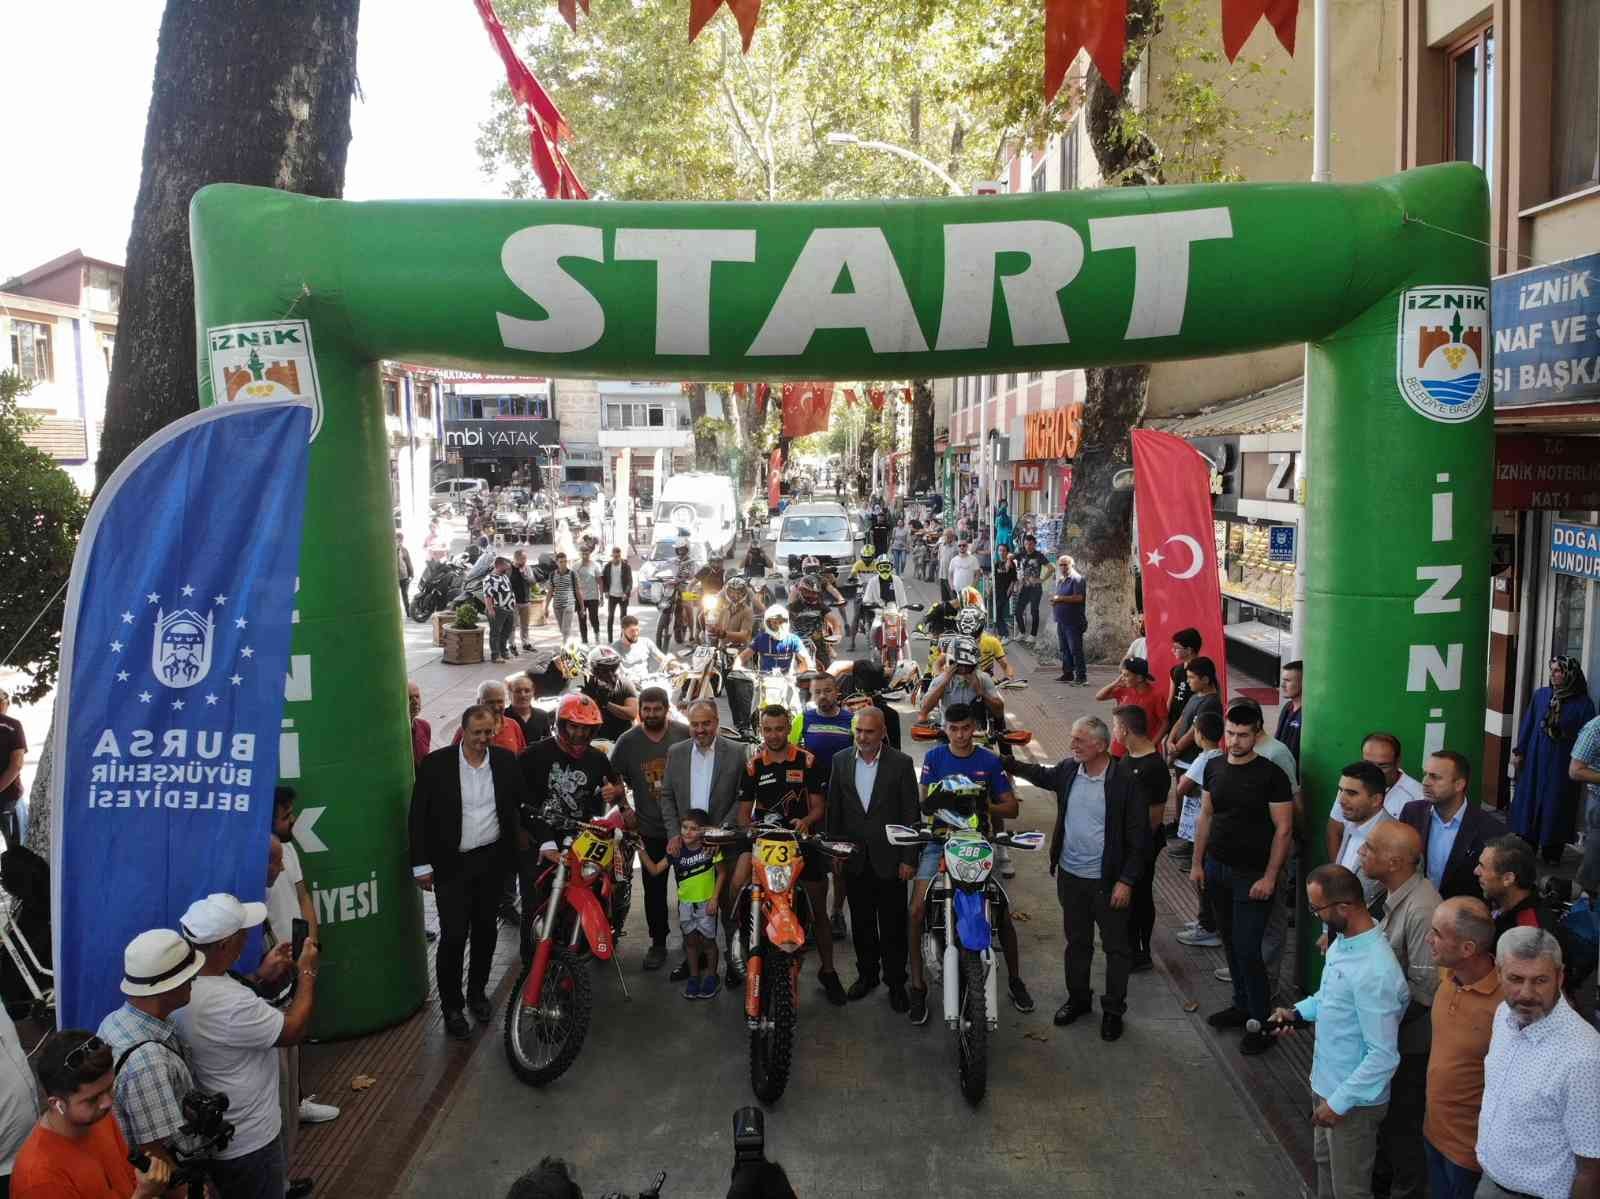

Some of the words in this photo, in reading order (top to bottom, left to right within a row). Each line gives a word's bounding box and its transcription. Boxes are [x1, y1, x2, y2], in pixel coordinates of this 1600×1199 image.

[496, 207, 1233, 356] START
[1551, 315, 1587, 345] VE
[487, 431, 539, 446] YATAK
[1019, 466, 1040, 485] M
[584, 839, 608, 861] 19
[761, 844, 789, 863] 73
